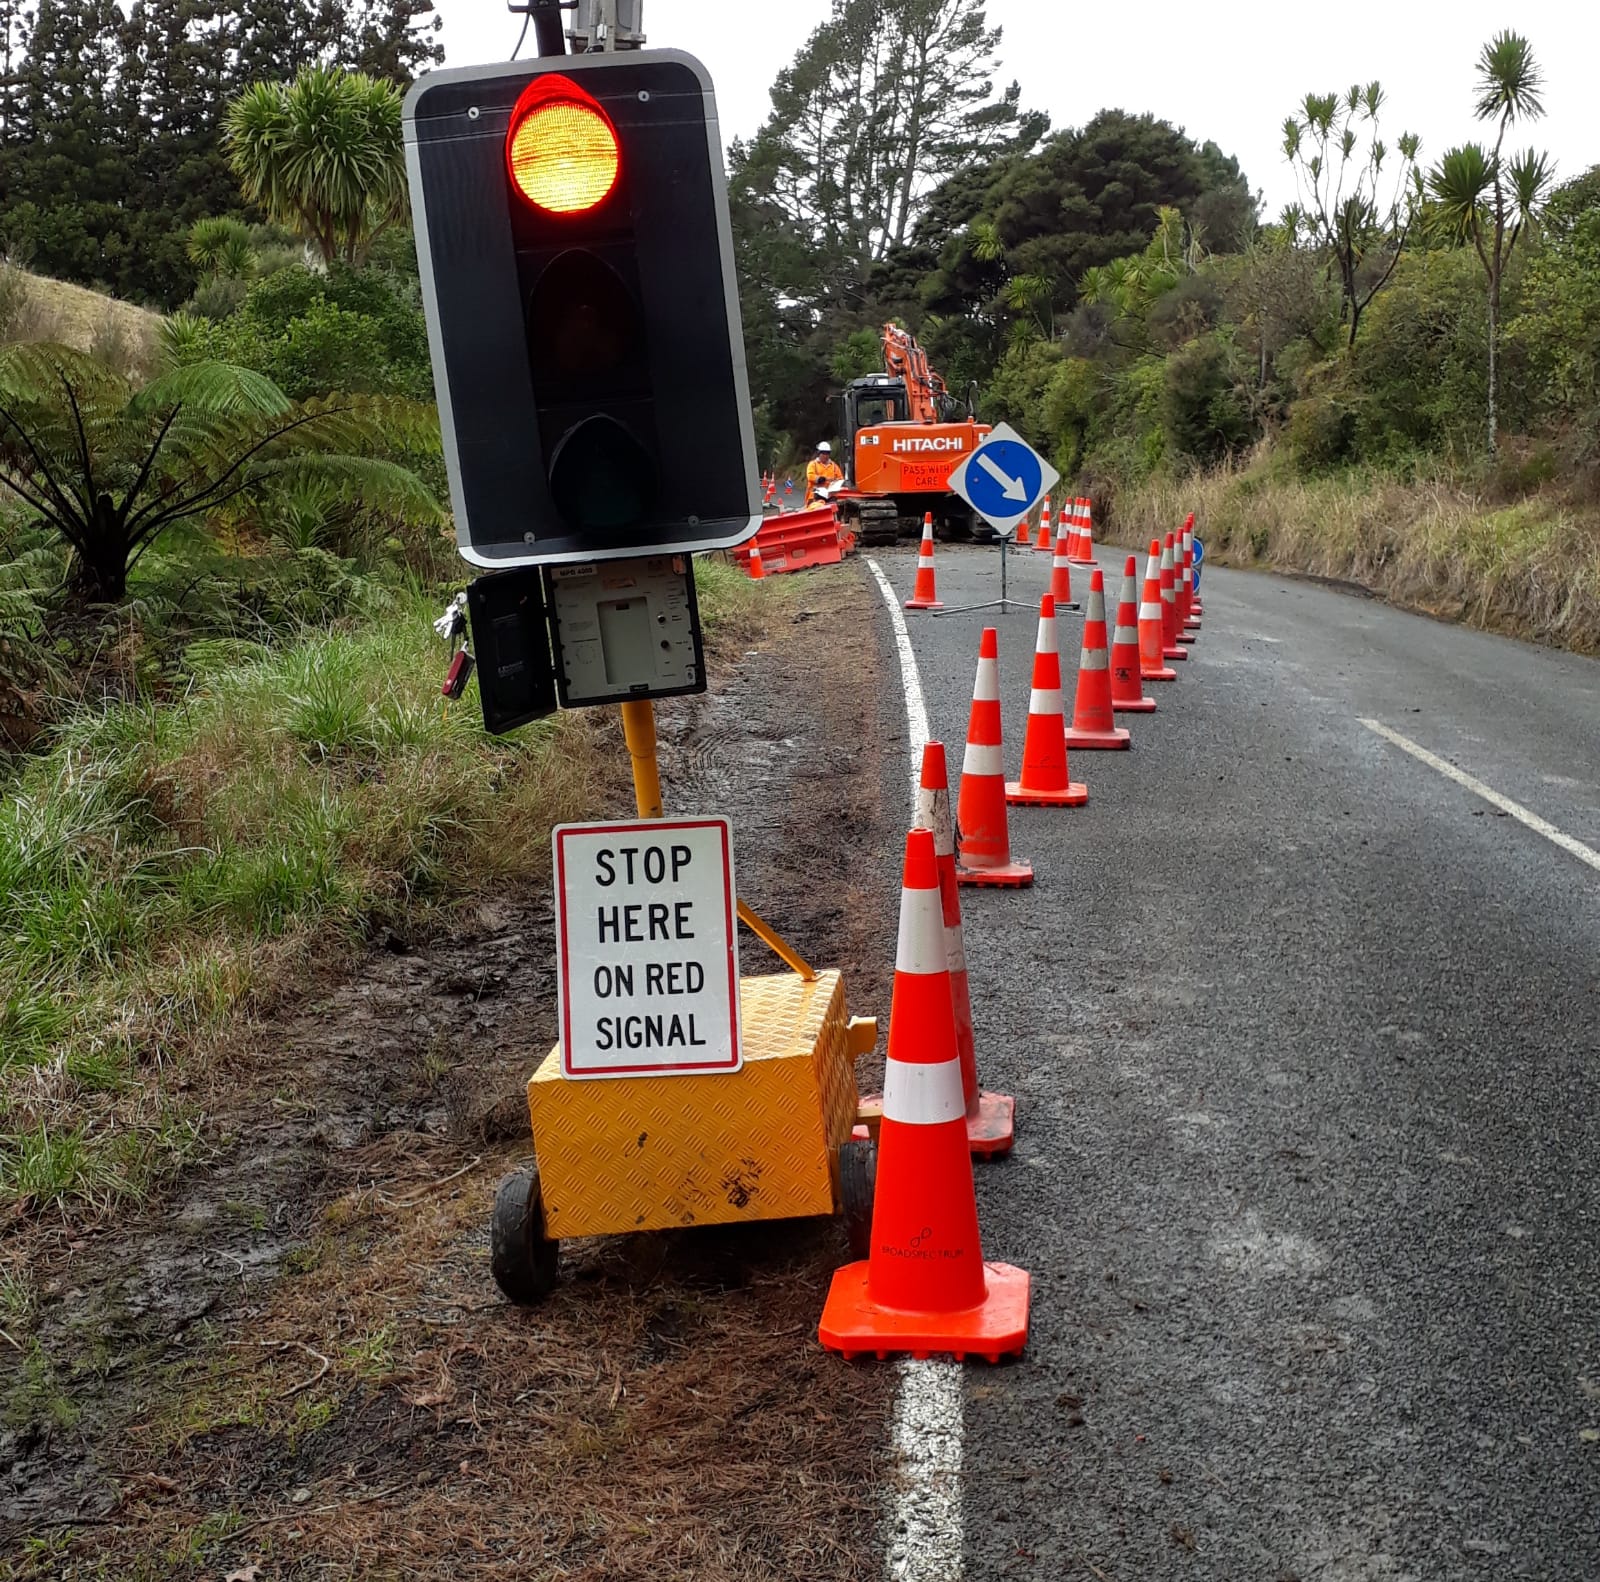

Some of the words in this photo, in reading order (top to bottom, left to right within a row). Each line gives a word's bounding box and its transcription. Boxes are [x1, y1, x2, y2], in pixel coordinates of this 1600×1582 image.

[893, 437, 963, 451] HITACHI
[903, 465, 926, 475] PASS
[928, 464, 950, 474] WITH
[915, 476, 938, 486] CARE
[595, 845, 692, 887] STOP
[598, 902, 695, 943] HERE
[594, 965, 634, 998] ON
[646, 961, 704, 995] RED
[595, 1013, 706, 1050] SIGNAL
